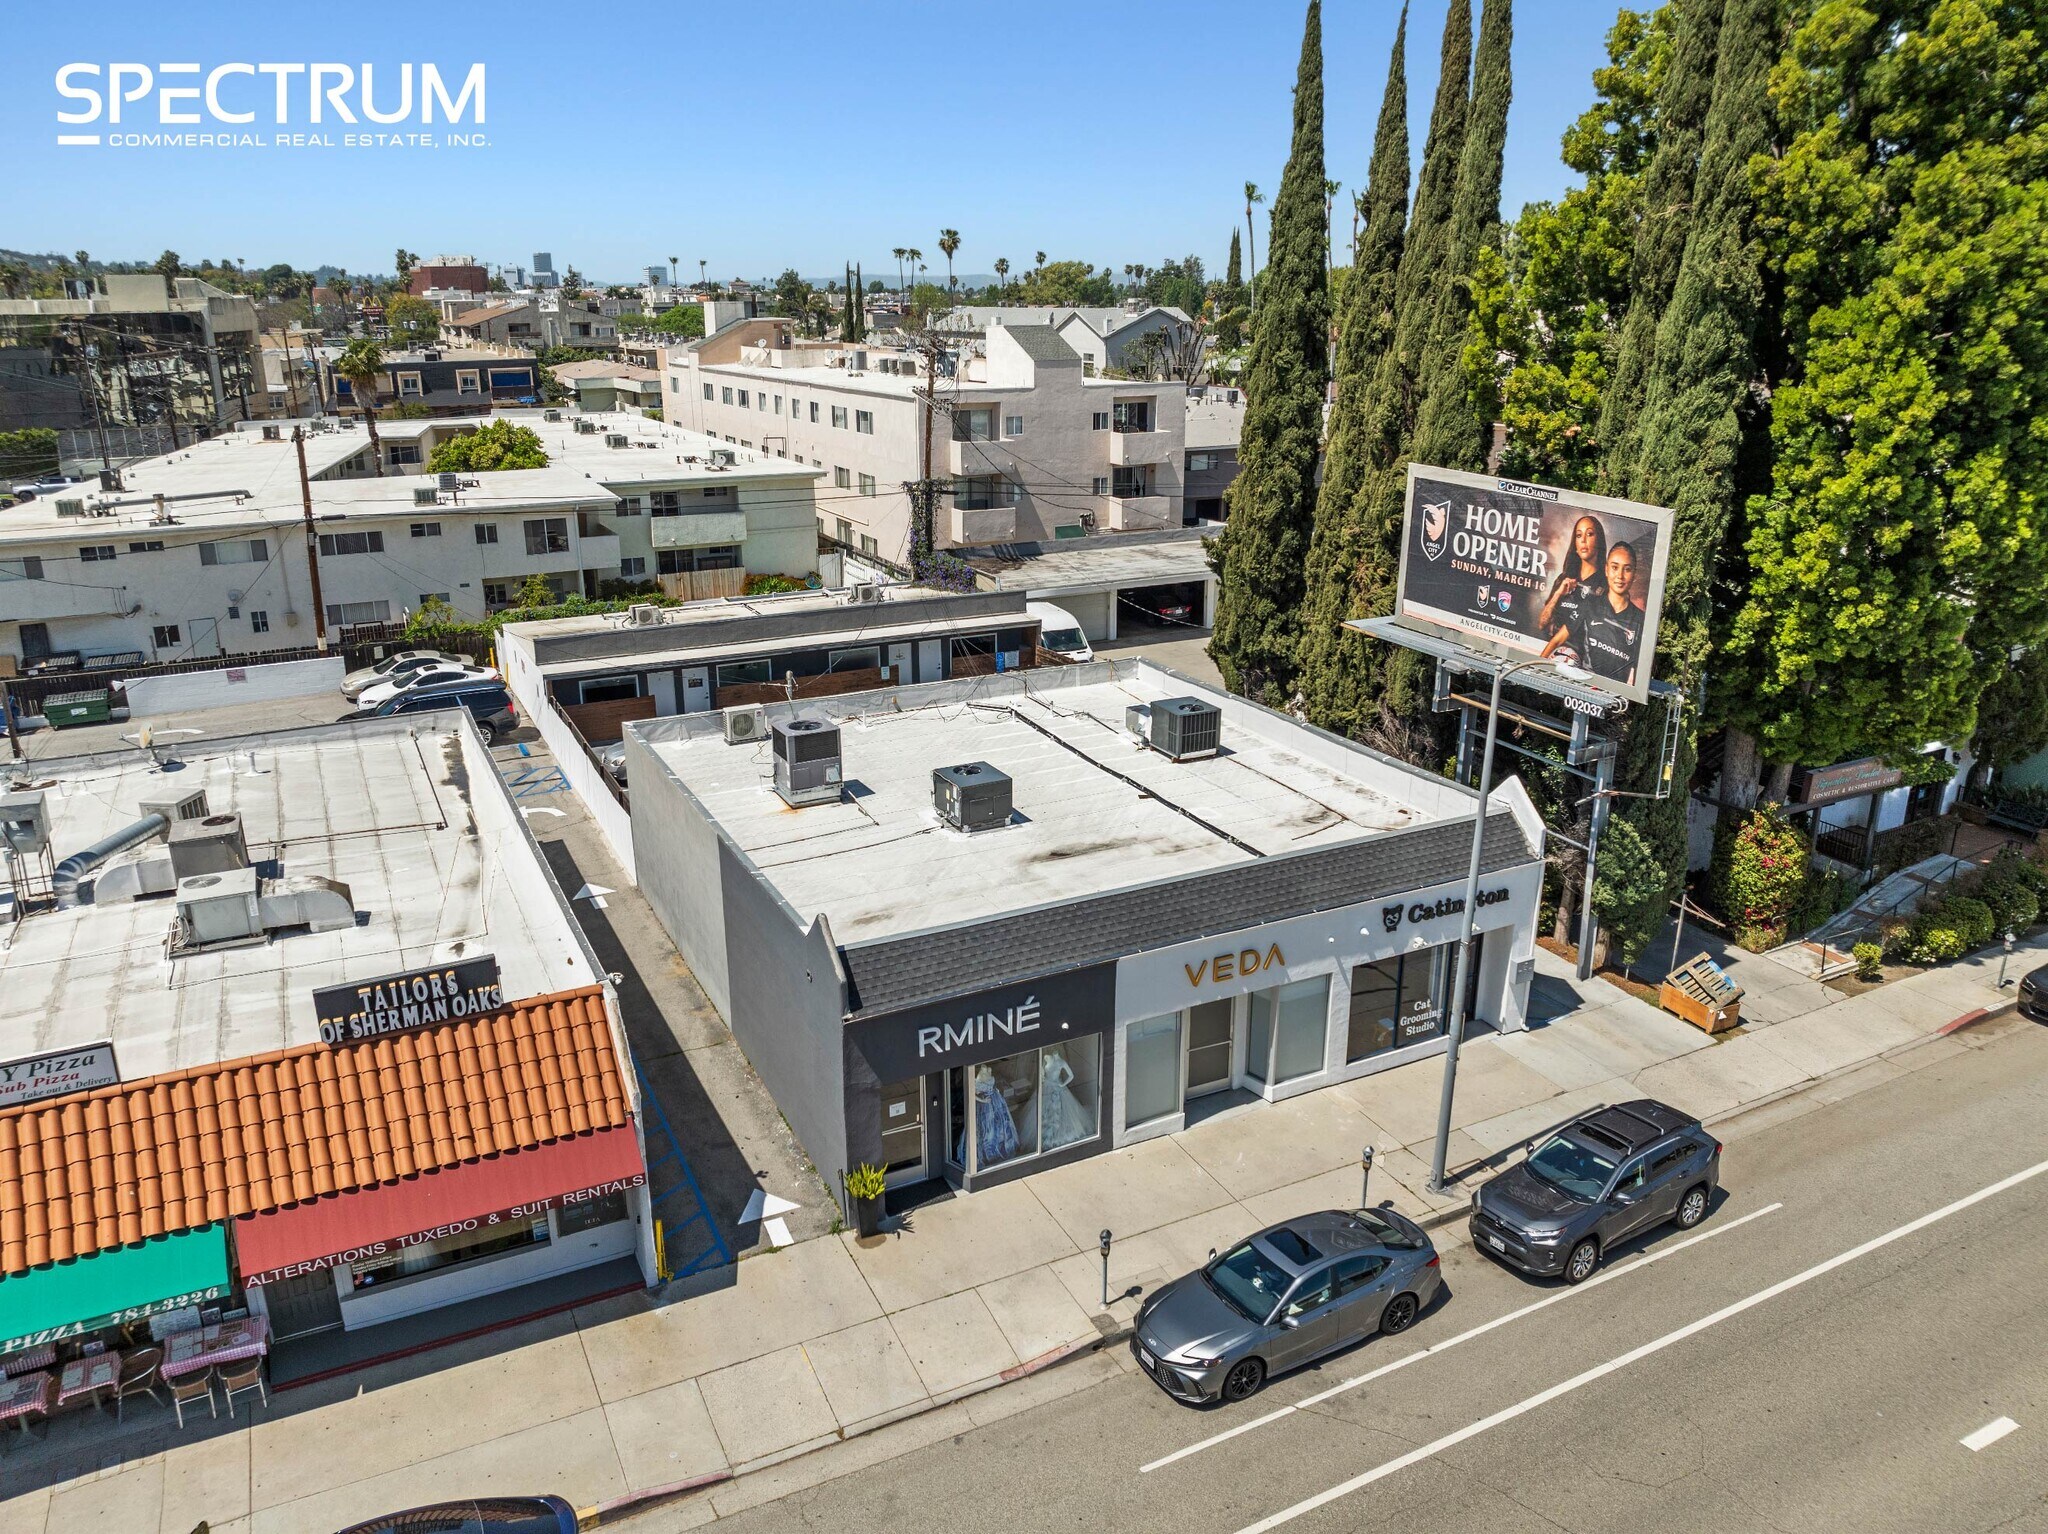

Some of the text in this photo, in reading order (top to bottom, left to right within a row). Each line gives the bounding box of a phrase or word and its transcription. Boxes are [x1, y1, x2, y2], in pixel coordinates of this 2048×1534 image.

[1465, 504, 1540, 545] HOME
[1453, 531, 1548, 577] OPENER
[1451, 559, 1546, 592] SUNDAY, MARCH 16
[1460, 618, 1521, 642] ANGELCITY.COM
[1598, 642, 1631, 661] DOORDASH
[1564, 695, 1603, 717] 002037
[1408, 888, 1510, 924] Catinton
[1185, 943, 1285, 988] VEDA
[358, 970, 459, 1013] TAILORS
[1414, 999, 1431, 1011] Cat
[320, 984, 504, 1045] OF SHERMAN OAKS
[918, 995, 1040, 1057] RMINÉ
[1400, 1008, 1443, 1026] Grooming
[1406, 1021, 1435, 1036] Studio
[27, 1054, 96, 1079] Pizza
[33, 1072, 80, 1088] Pizza
[21, 1076, 113, 1099] Take out & Delivery
[246, 1242, 387, 1288] ALTERATIONS
[396, 1219, 478, 1248] TUXEDO
[488, 1213, 500, 1225] &
[511, 1199, 552, 1219] SUIT
[563, 1175, 644, 1205] RENTALS
[4, 1321, 85, 1352] PIZZA
[110, 1287, 218, 1324] 784-3226
